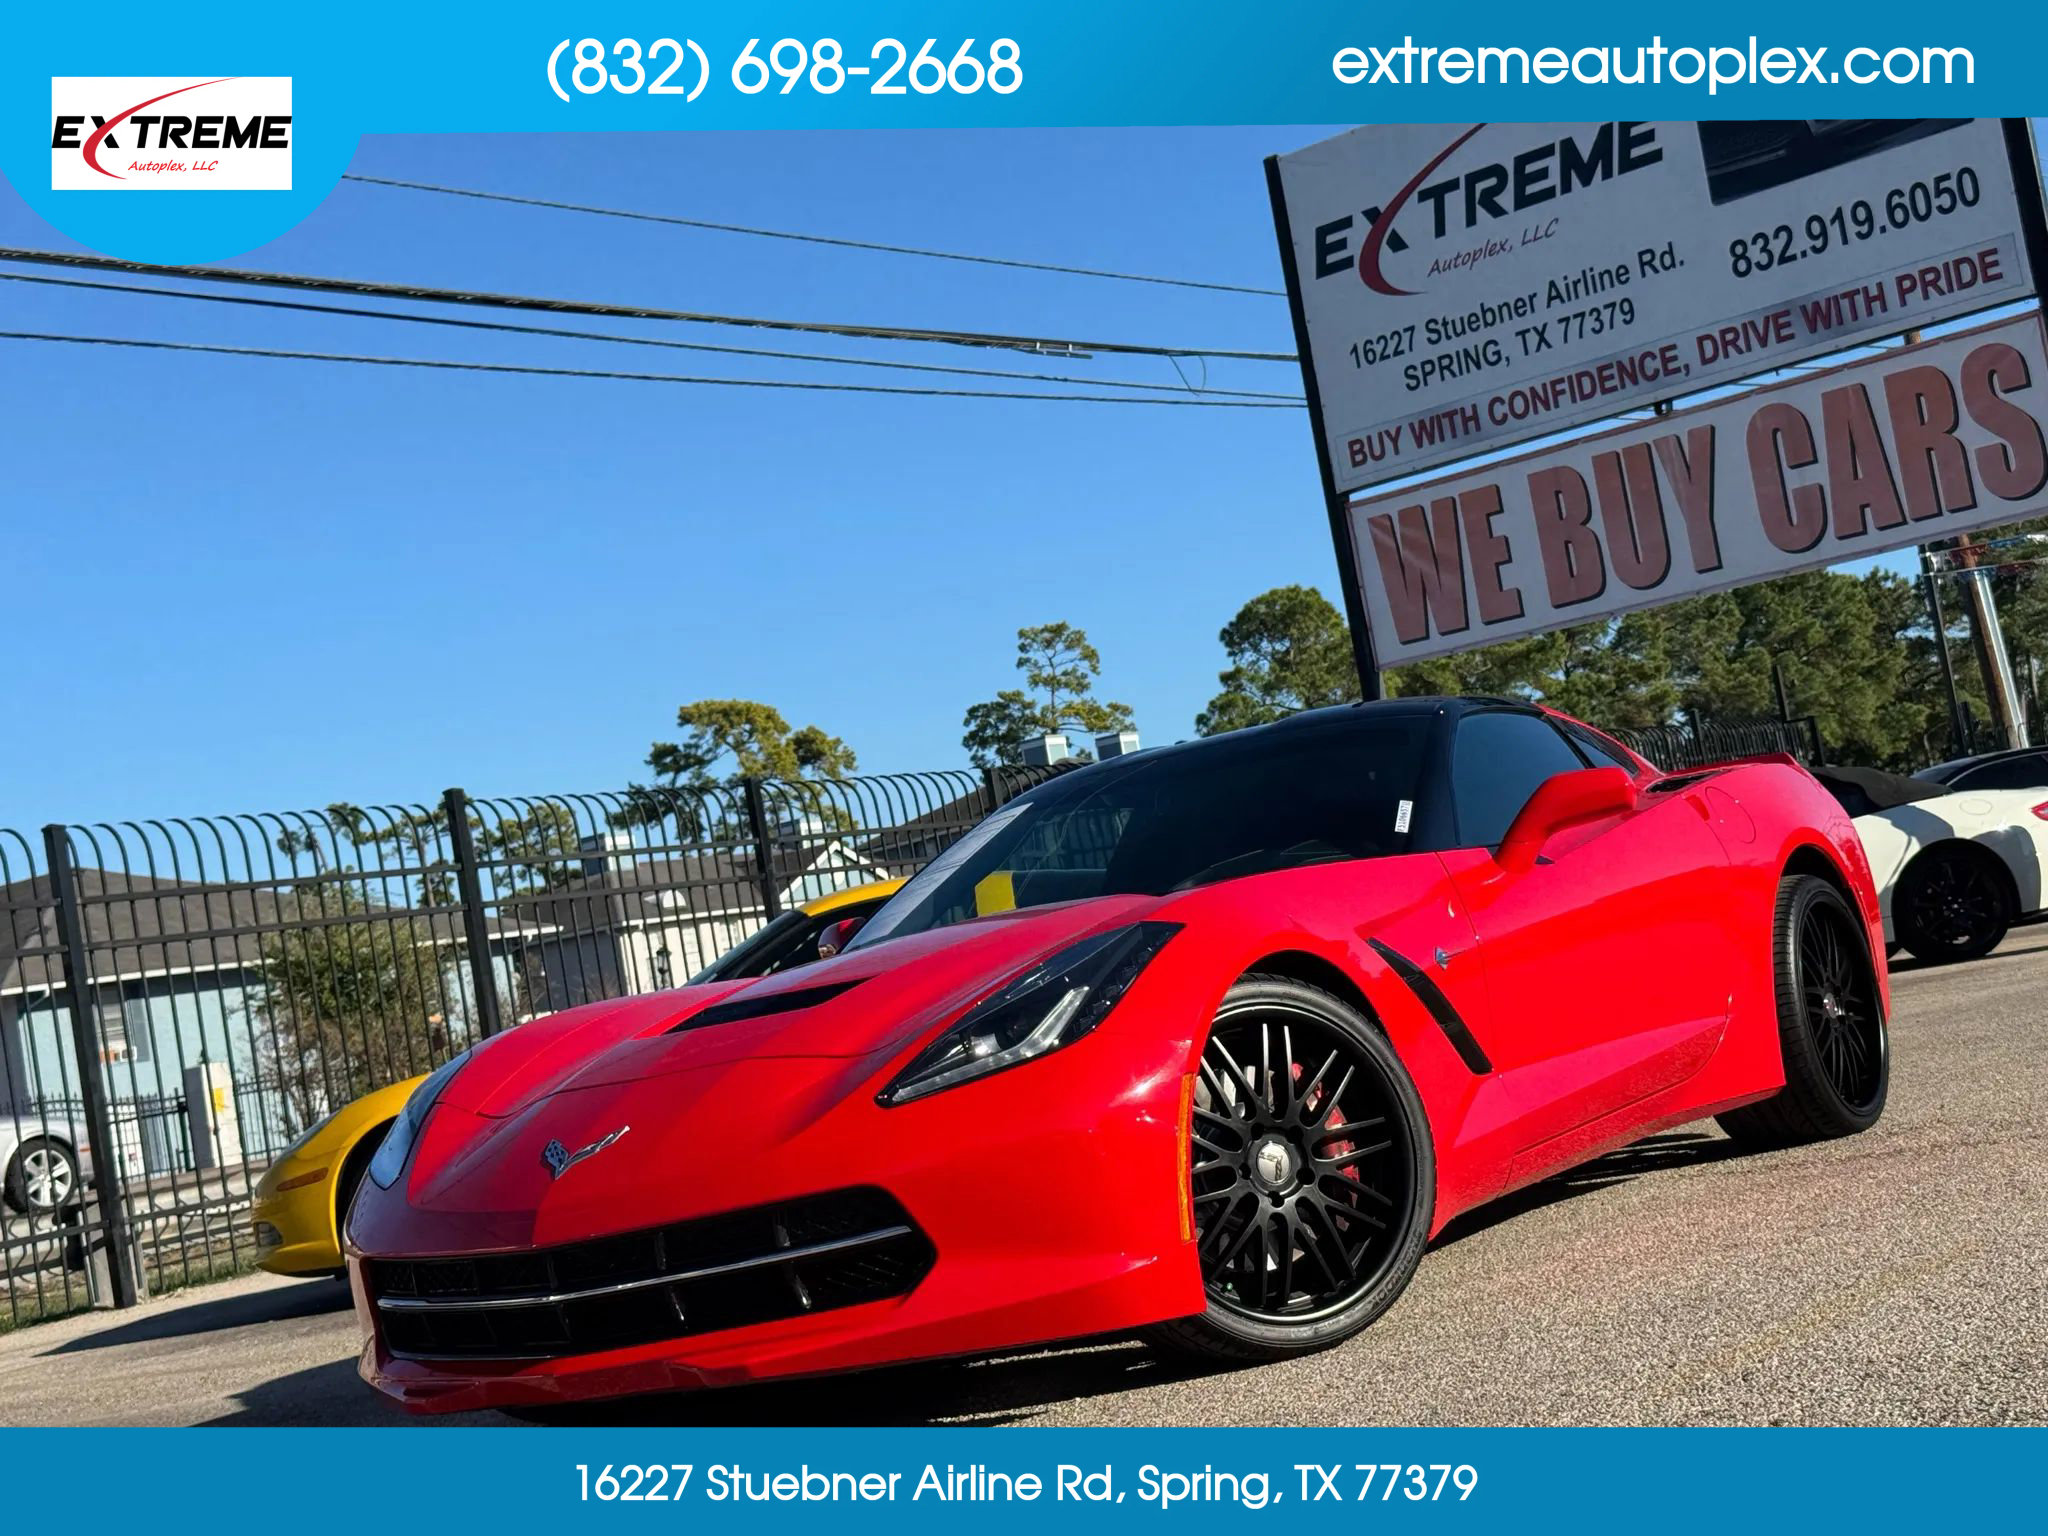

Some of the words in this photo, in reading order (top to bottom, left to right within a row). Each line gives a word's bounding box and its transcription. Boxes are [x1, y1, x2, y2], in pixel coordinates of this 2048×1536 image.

[1315, 121, 1663, 280] EXTREME
[1427, 236, 1513, 278] Autoplex,
[1520, 217, 1560, 247] LLC
[1728, 166, 1981, 279] 832.919.6050
[1347, 424, 1403, 469] BUY
[1408, 403, 1482, 450] WITH
[1487, 343, 1692, 427] CONFIDENCE,
[1696, 309, 1796, 366] DRIVE
[1799, 281, 1888, 335] WITH
[1895, 247, 2004, 307] PRIDE
[1349, 325, 1416, 369] 16227
[1424, 290, 1537, 346] Stuebner
[1546, 263, 1631, 309] Airline
[1637, 241, 1686, 278] Rd.
[1404, 338, 1511, 392] SPRING,
[1515, 326, 1553, 357] TX
[1558, 297, 1636, 344] 77379
[1367, 484, 1524, 646] WE
[1527, 424, 1724, 609] BUY
[1745, 342, 2048, 555] CARS
